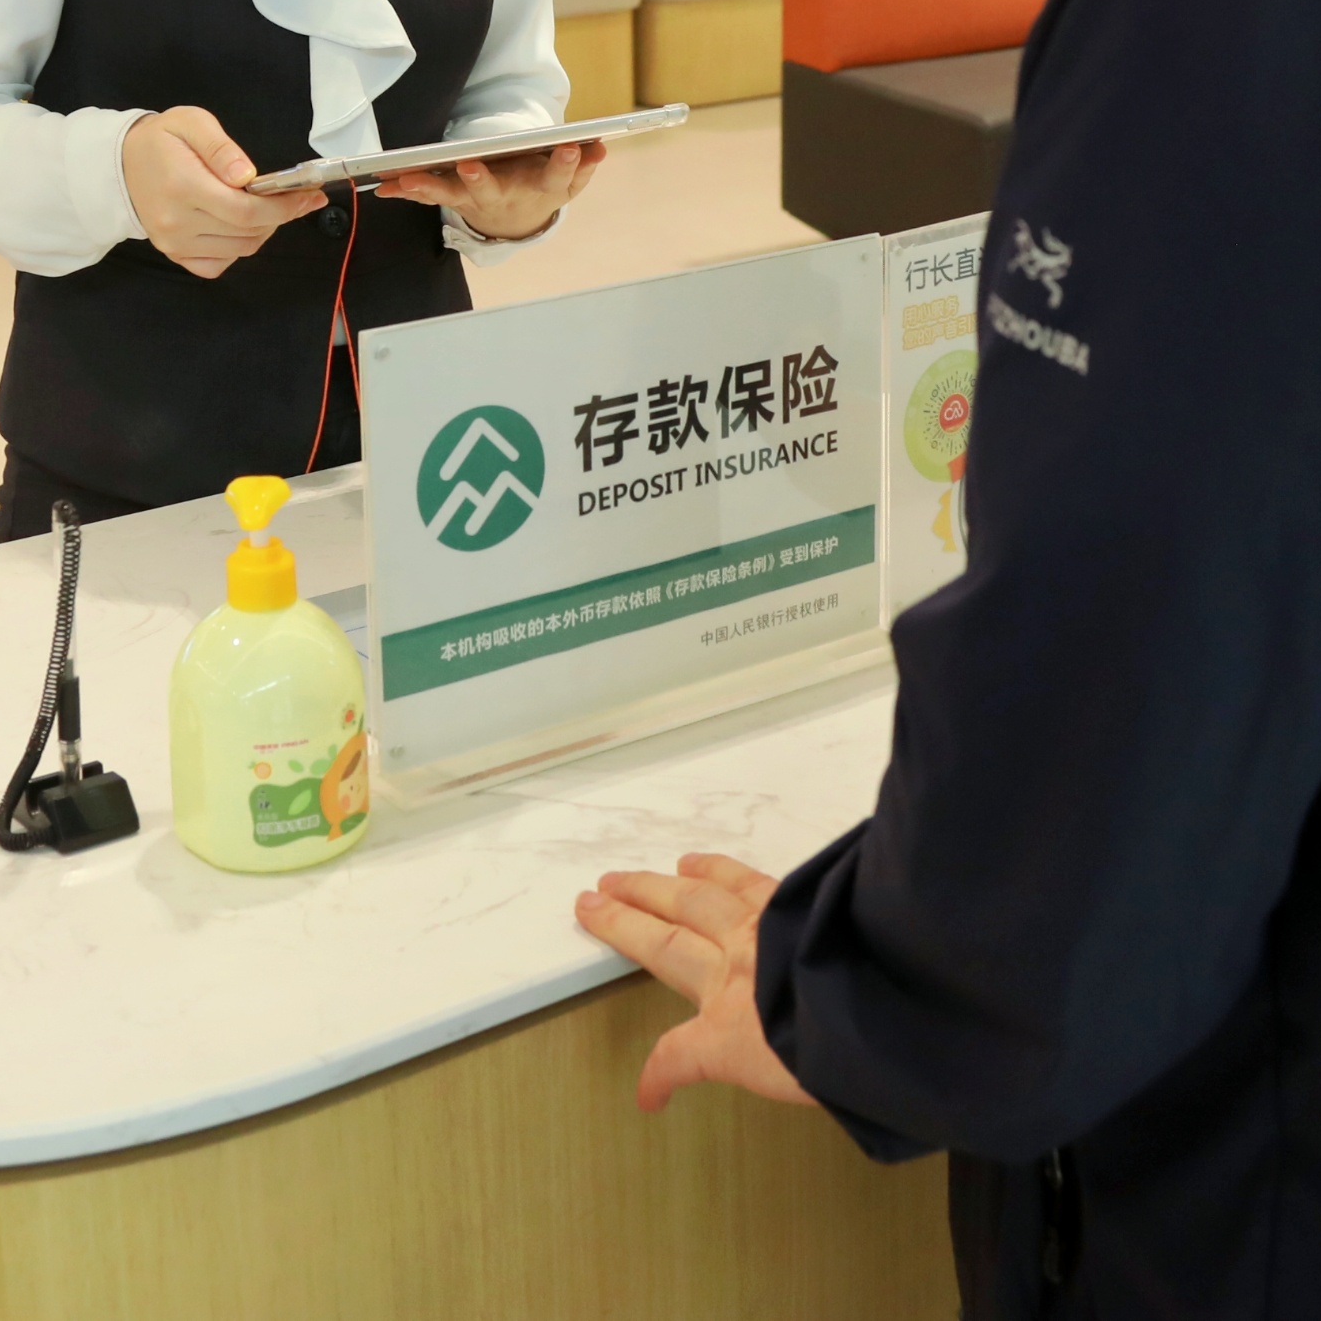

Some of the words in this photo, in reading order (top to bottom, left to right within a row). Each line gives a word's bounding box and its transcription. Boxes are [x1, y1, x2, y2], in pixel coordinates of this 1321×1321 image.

[905, 245, 984, 294] 行长直
[902, 294, 960, 329] 用心服务
[902, 311, 978, 352] 您的声音引
[573, 344, 839, 473] 存款保险
[578, 467, 688, 517] DEPOSIT
[694, 429, 839, 488] INSURANCE
[439, 535, 840, 663] 本机构吸收的本外币存款依照《存款保险条例》受到保护
[699, 592, 840, 648] 中国人民银行授权使用
